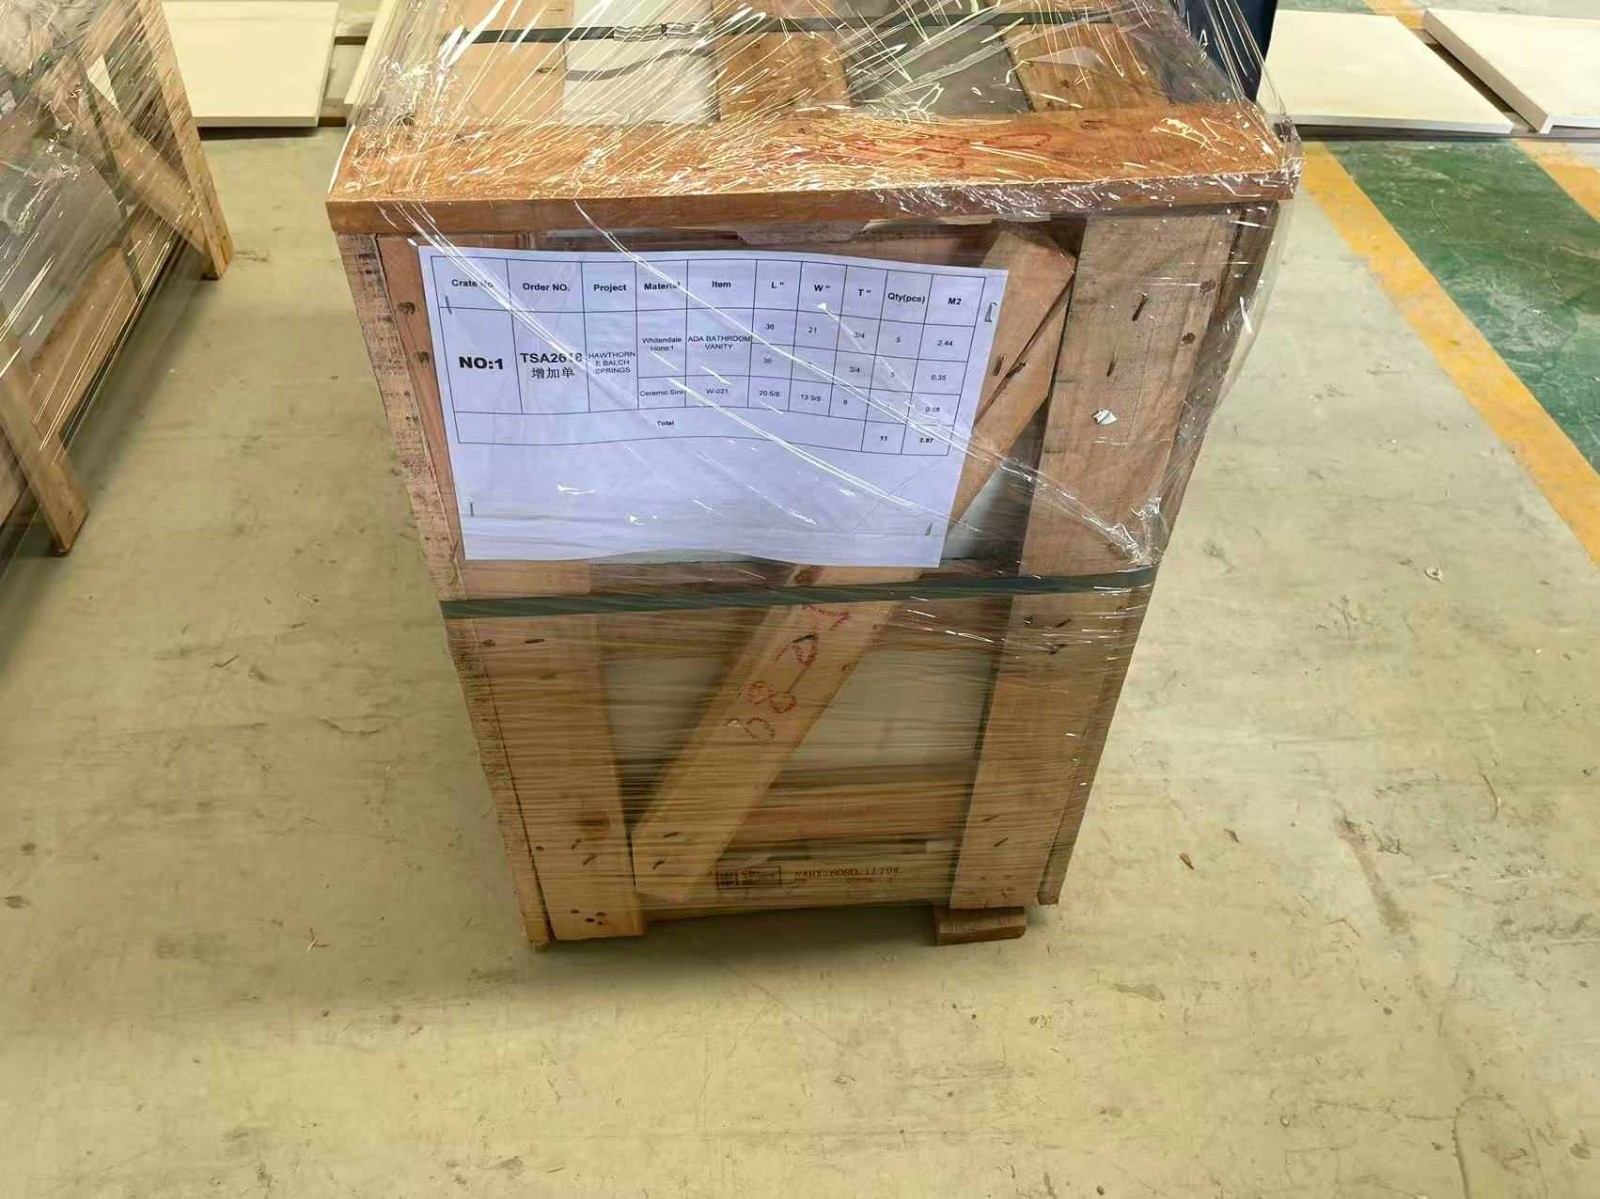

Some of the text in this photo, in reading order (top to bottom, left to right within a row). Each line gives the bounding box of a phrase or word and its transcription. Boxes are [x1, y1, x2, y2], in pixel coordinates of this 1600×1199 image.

[451, 278, 478, 288] Crate
[522, 282, 571, 292] Order NO.
[643, 282, 681, 290] Material
[711, 280, 732, 289] Item
[593, 283, 627, 293] Project
[887, 292, 926, 305] Qty(pcs)
[947, 297, 962, 306] M2
[808, 326, 817, 334] 21
[705, 335, 751, 343] BATHROOM
[853, 331, 865, 339] 3/4
[641, 336, 682, 344] Whitendale
[937, 339, 953, 347] 2.44
[588, 351, 636, 360] HAWTHORN
[458, 356, 504, 370] NO:1
[595, 359, 630, 367] E BALCH
[531, 367, 575, 379] 增加单
[595, 367, 631, 375] SPRINGS
[849, 366, 860, 374] 3/4
[639, 389, 668, 397] Ceramic
